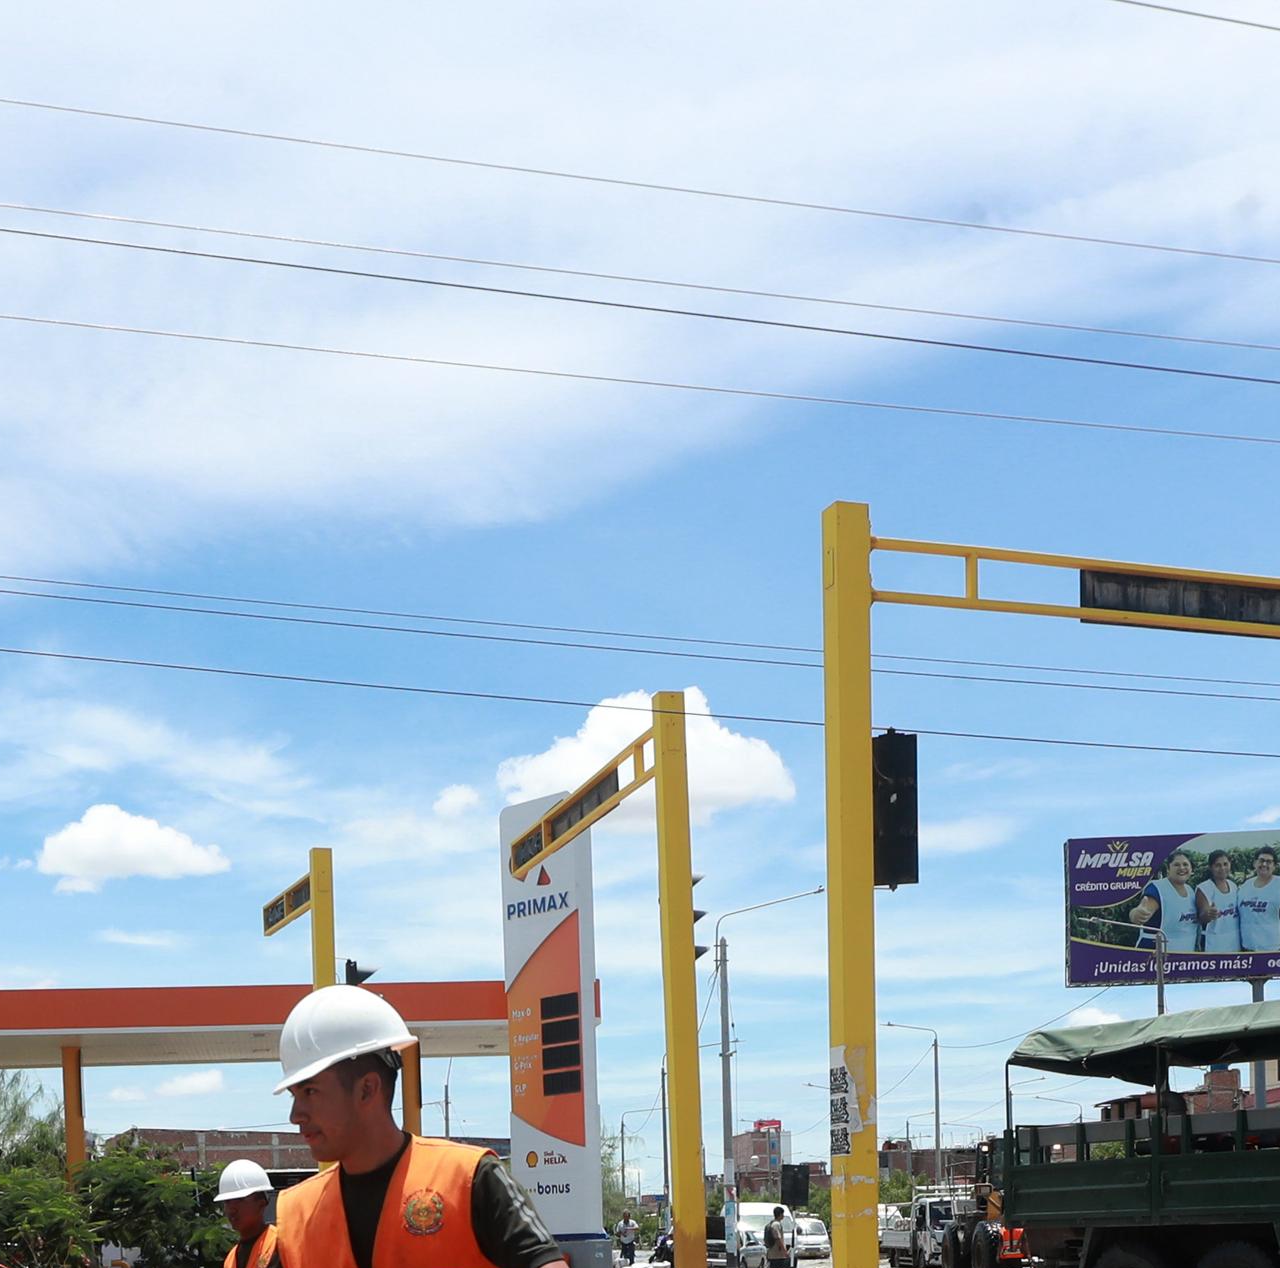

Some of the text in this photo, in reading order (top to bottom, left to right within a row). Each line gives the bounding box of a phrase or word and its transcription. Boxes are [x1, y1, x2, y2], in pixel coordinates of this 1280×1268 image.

[1116, 866, 1153, 879] MUJER
[1075, 881, 1142, 892] CRÉDITO GRUPAL
[507, 891, 569, 920] PRIMAX
[1094, 960, 1146, 977] ¡Unidas
[1219, 956, 1253, 970] más!
[543, 1154, 568, 1165] HELIX
[537, 1181, 571, 1195] bonus
